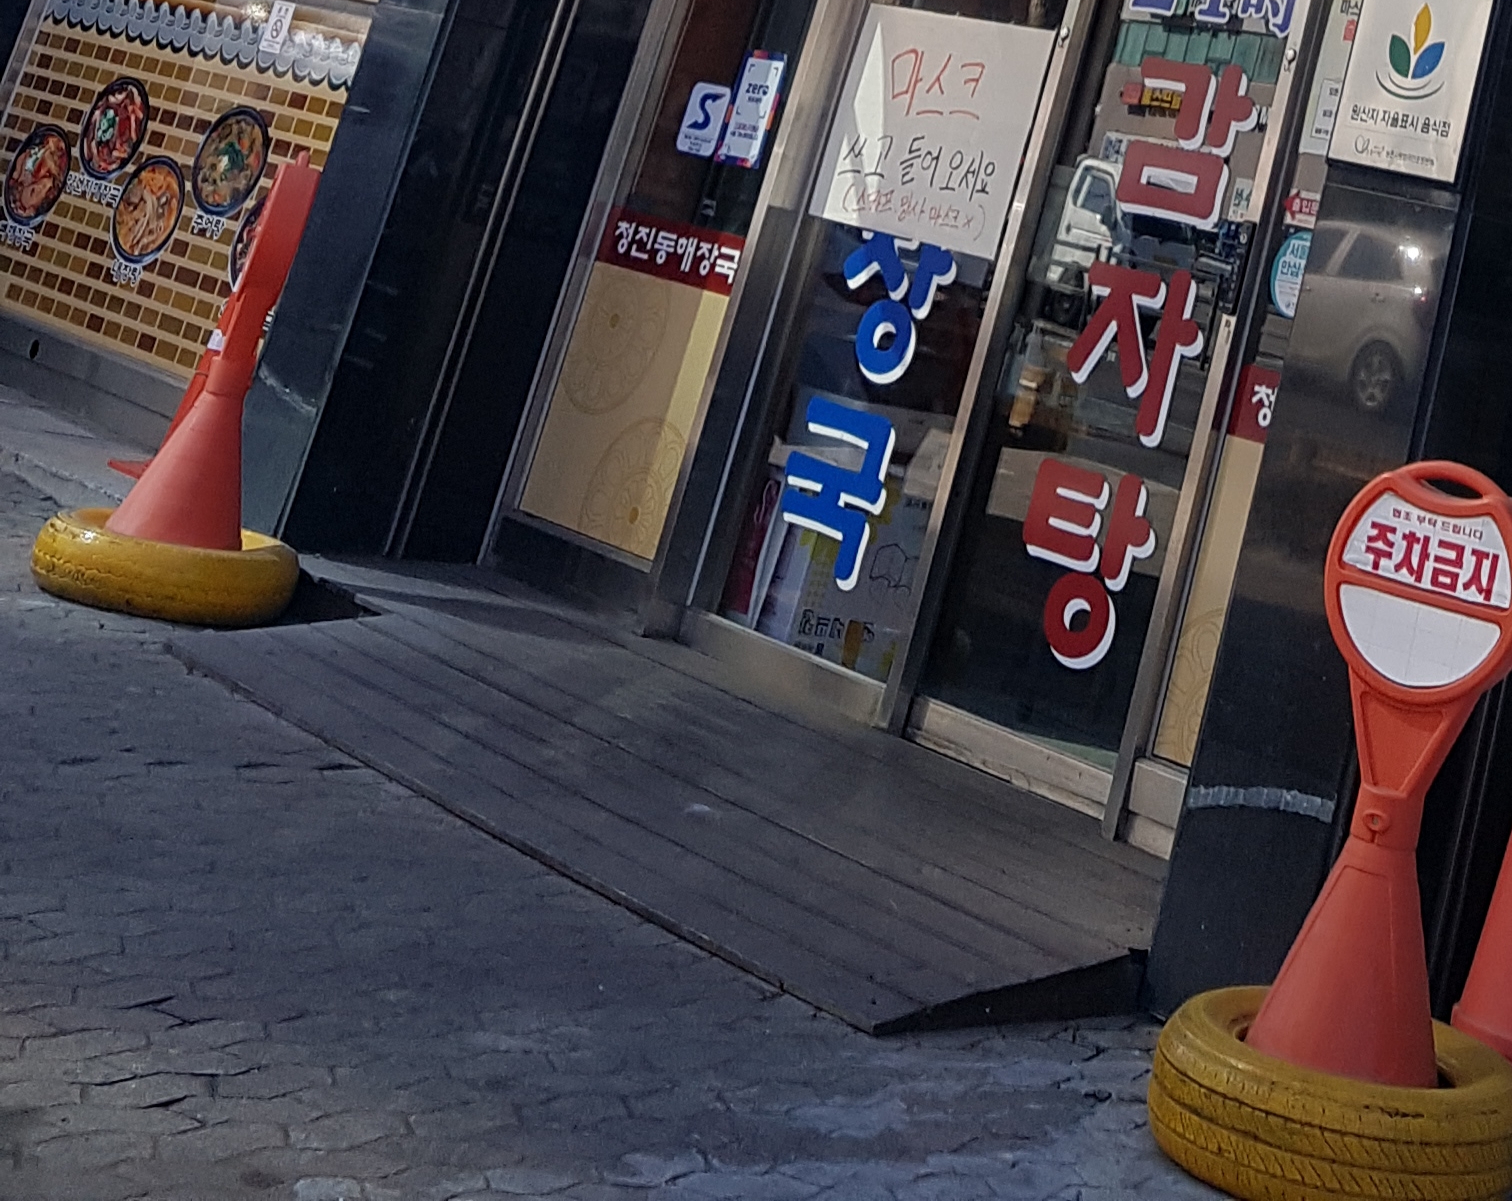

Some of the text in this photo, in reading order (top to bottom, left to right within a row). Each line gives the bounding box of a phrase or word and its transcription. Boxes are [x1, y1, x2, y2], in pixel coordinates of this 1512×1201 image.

[890, 48, 986, 120] 마스크
[1350, 103, 1379, 126] 원산지
[1380, 108, 1420, 132] 자율표시
[1421, 115, 1451, 138] 음식점
[837, 134, 893, 179] 쓰고
[193, 211, 226, 240] 추어탕
[615, 219, 742, 285] 청진동해장국
[1023, 57, 1257, 670] 감자탕
[1440, 519, 1484, 541] 드립니다
[1364, 520, 1501, 602] 주차금지
